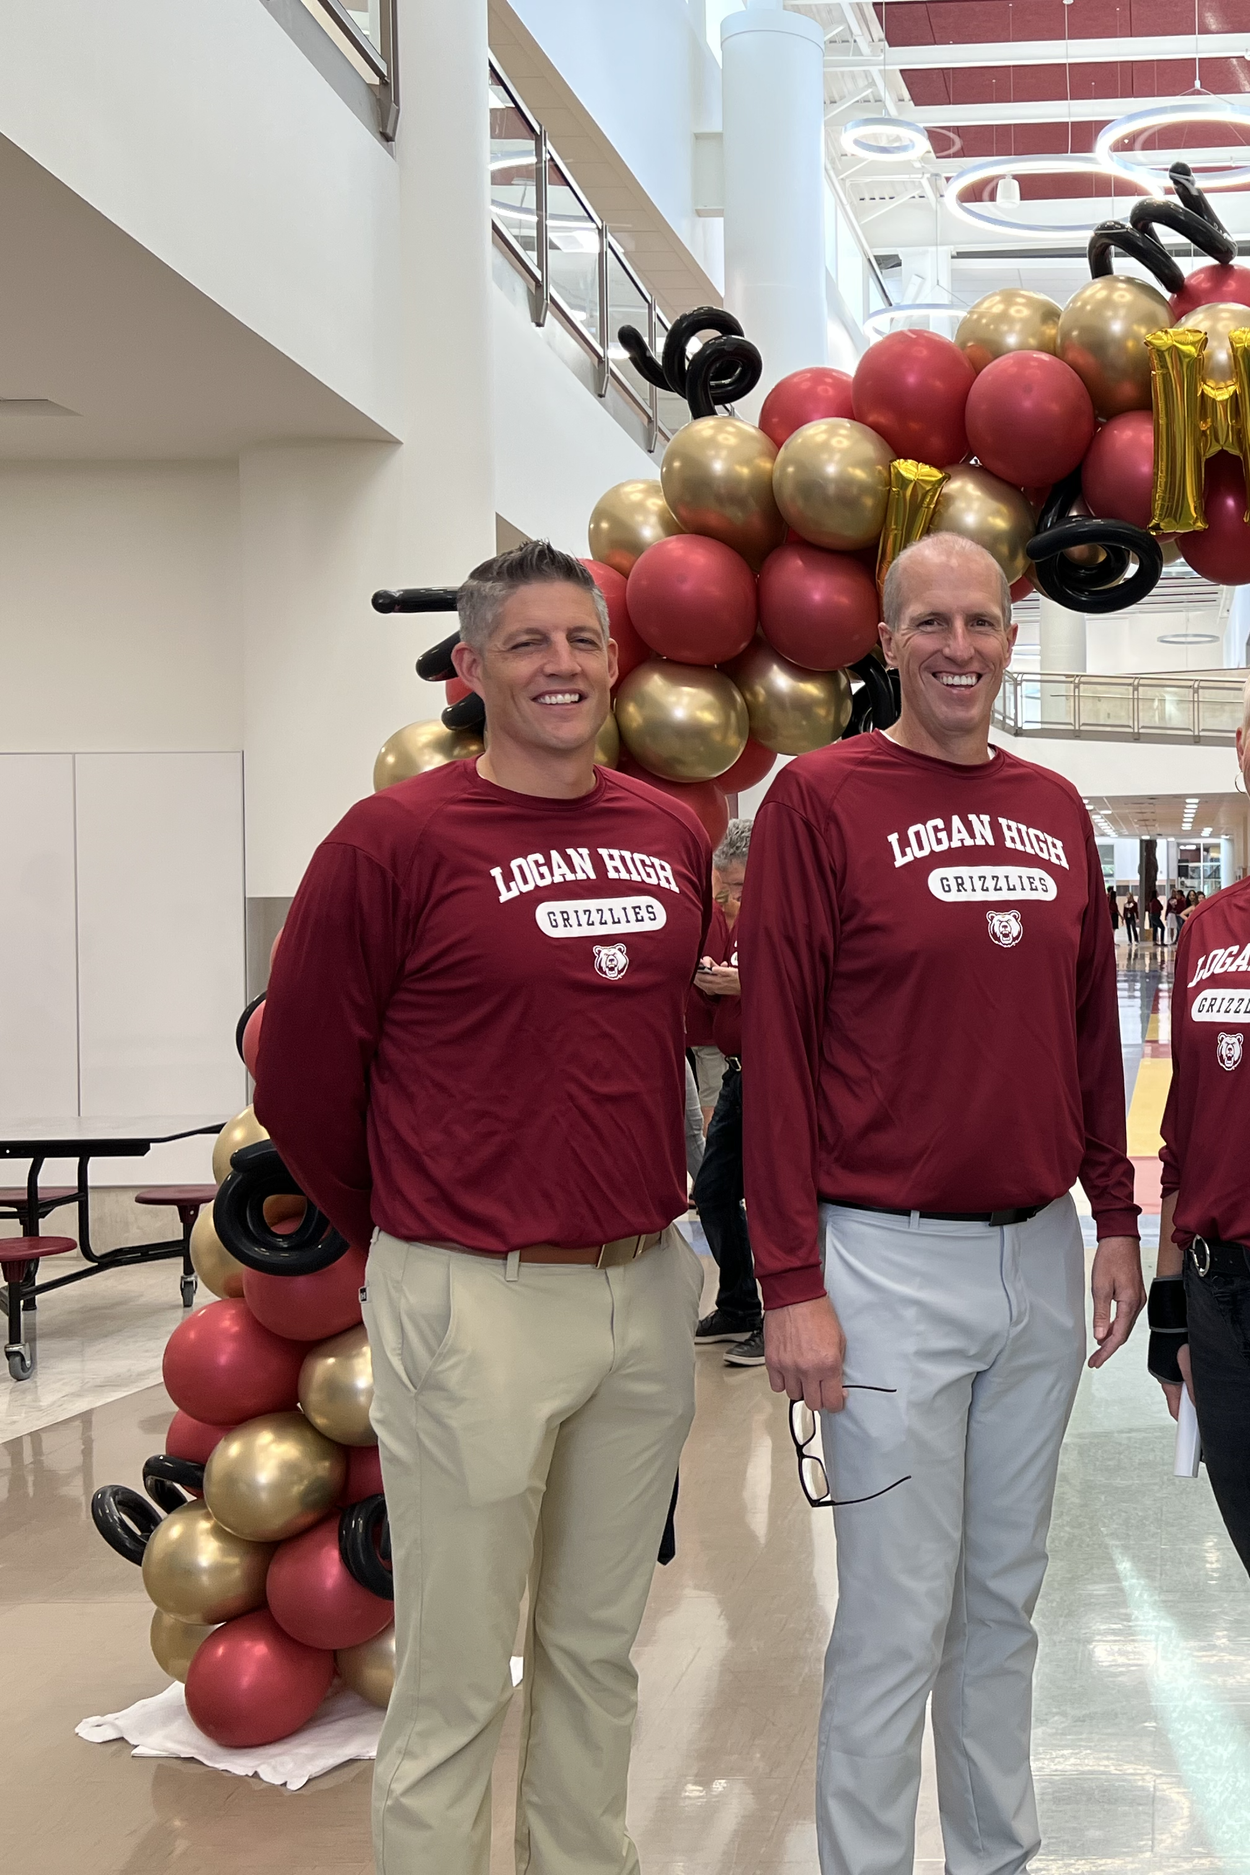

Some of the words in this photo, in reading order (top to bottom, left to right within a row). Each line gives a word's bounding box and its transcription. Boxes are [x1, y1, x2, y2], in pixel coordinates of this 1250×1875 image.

[887, 814, 995, 868] LOGAN
[997, 816, 1070, 871] HIGH
[489, 848, 597, 904] LOGAN
[596, 847, 680, 894] HIGH
[940, 875, 1049, 893] GRIZZLIES
[547, 904, 657, 929] GRIZZLIES
